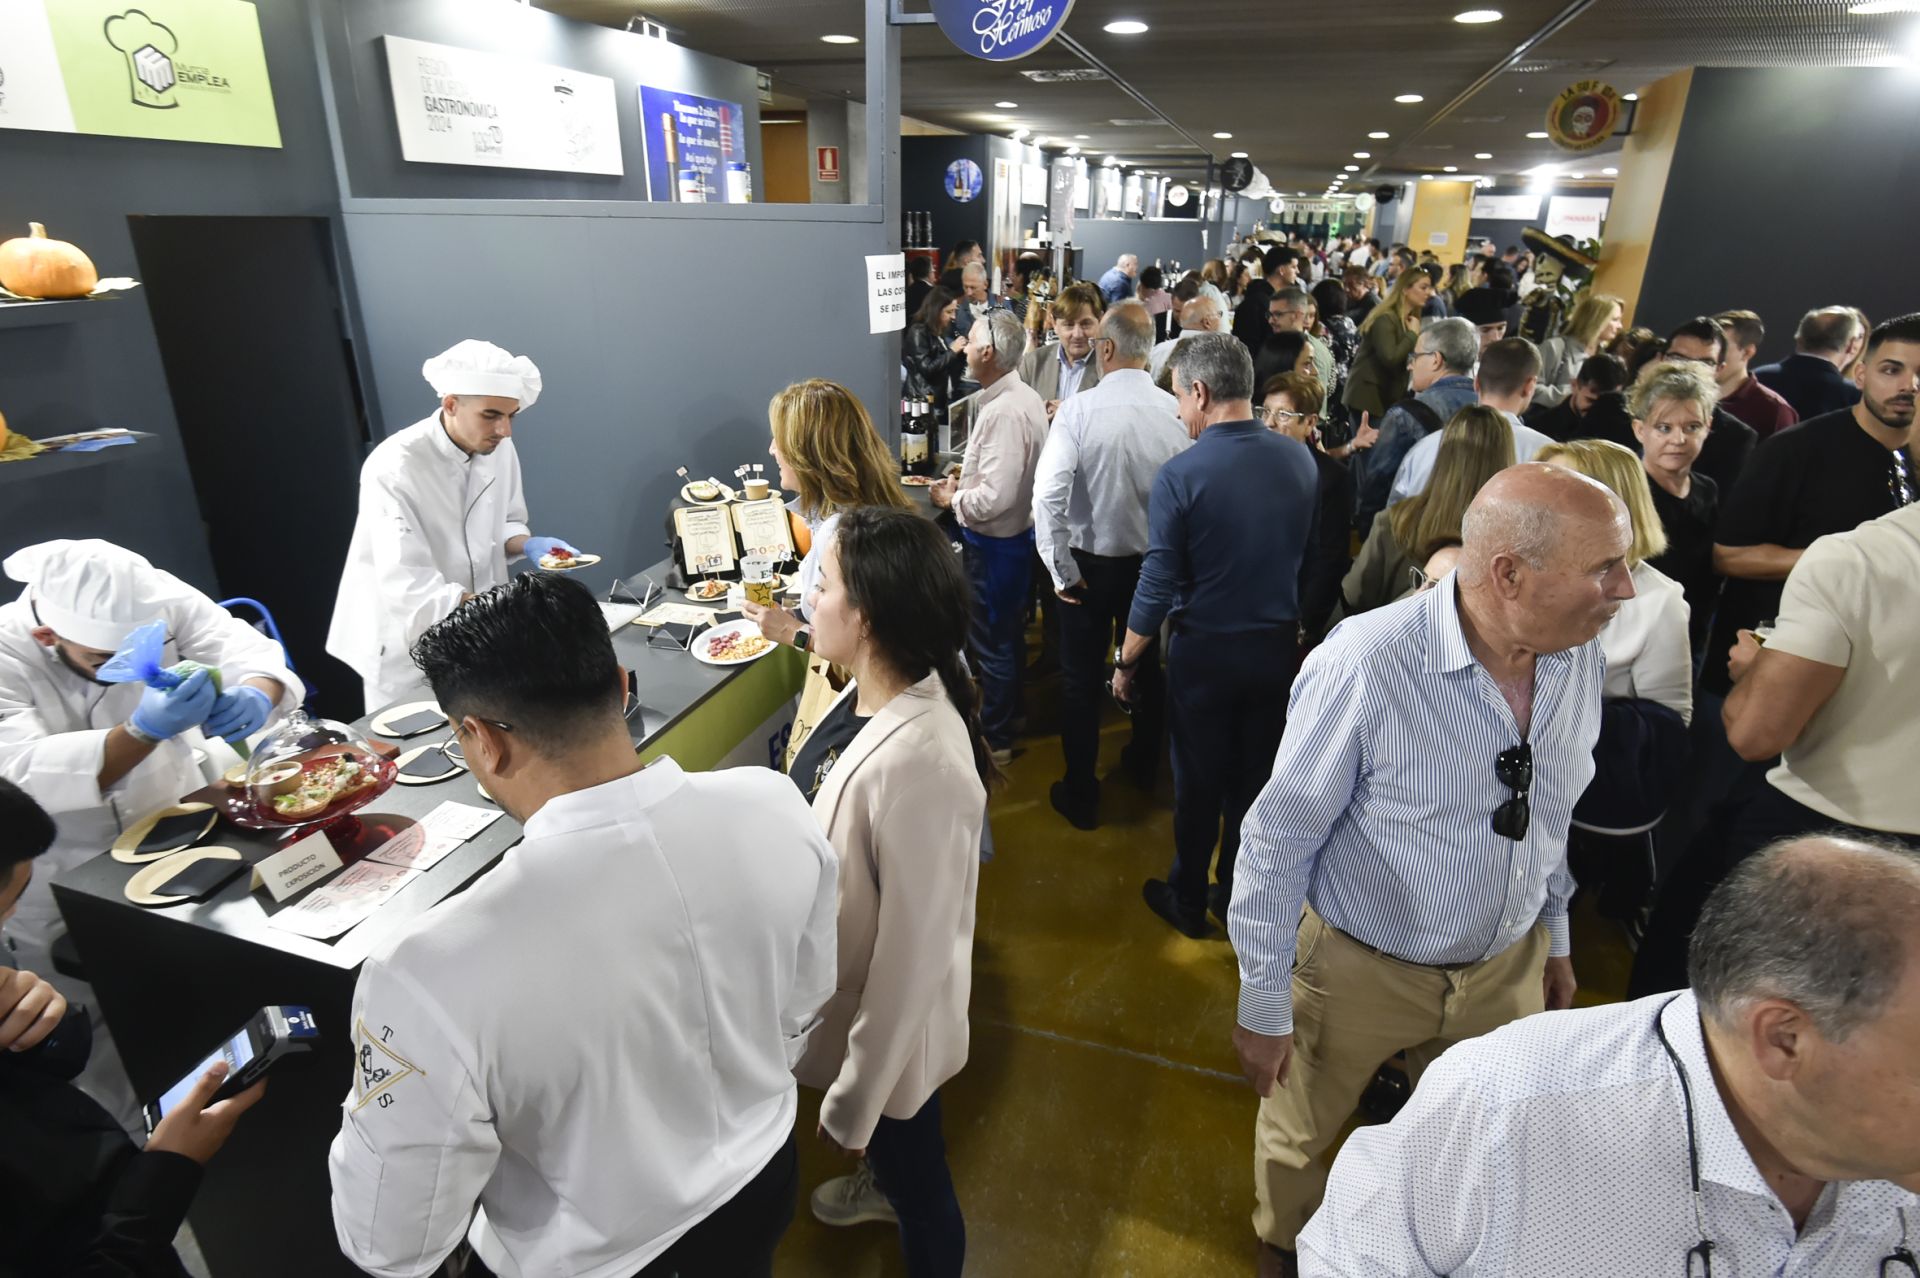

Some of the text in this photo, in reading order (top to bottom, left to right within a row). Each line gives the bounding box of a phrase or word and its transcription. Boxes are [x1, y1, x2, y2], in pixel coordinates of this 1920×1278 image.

[981, 5, 1053, 54] Hermoso
[177, 71, 231, 89] EMPLEA
[427, 114, 453, 133] 2024
[876, 271, 886, 280] EL
[877, 287, 892, 297] LAS
[880, 304, 889, 313] SE
[278, 853, 318, 878] PRODUCTO
[379, 1025, 394, 1043] T
[377, 1092, 395, 1109] S
